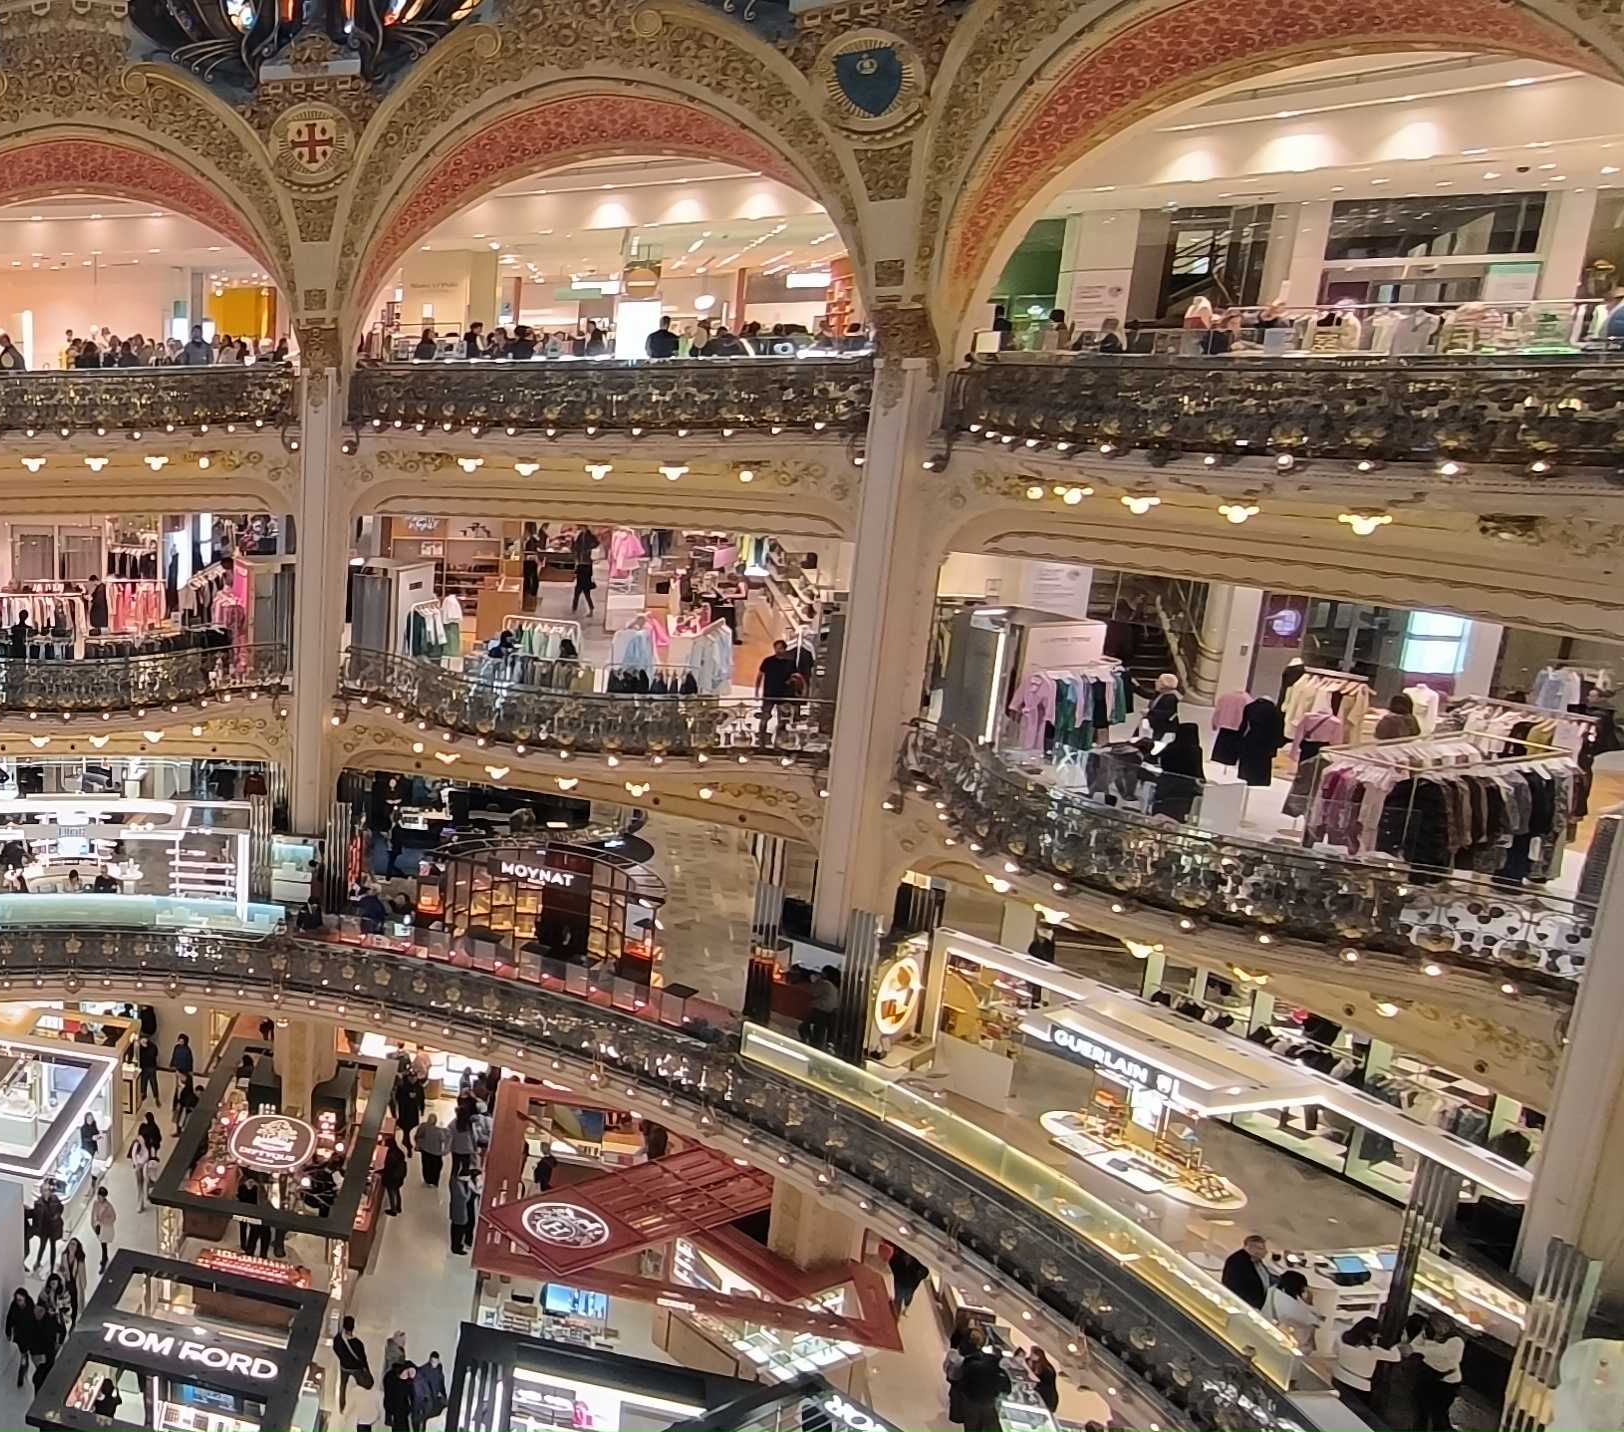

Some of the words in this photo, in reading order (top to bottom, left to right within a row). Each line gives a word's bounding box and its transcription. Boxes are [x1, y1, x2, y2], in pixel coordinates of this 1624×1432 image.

[500, 860, 575, 887] MOYNAT
[1053, 1028, 1149, 1084] GUERLAIN
[102, 1321, 175, 1356] TOM
[178, 1340, 278, 1379] FORD
